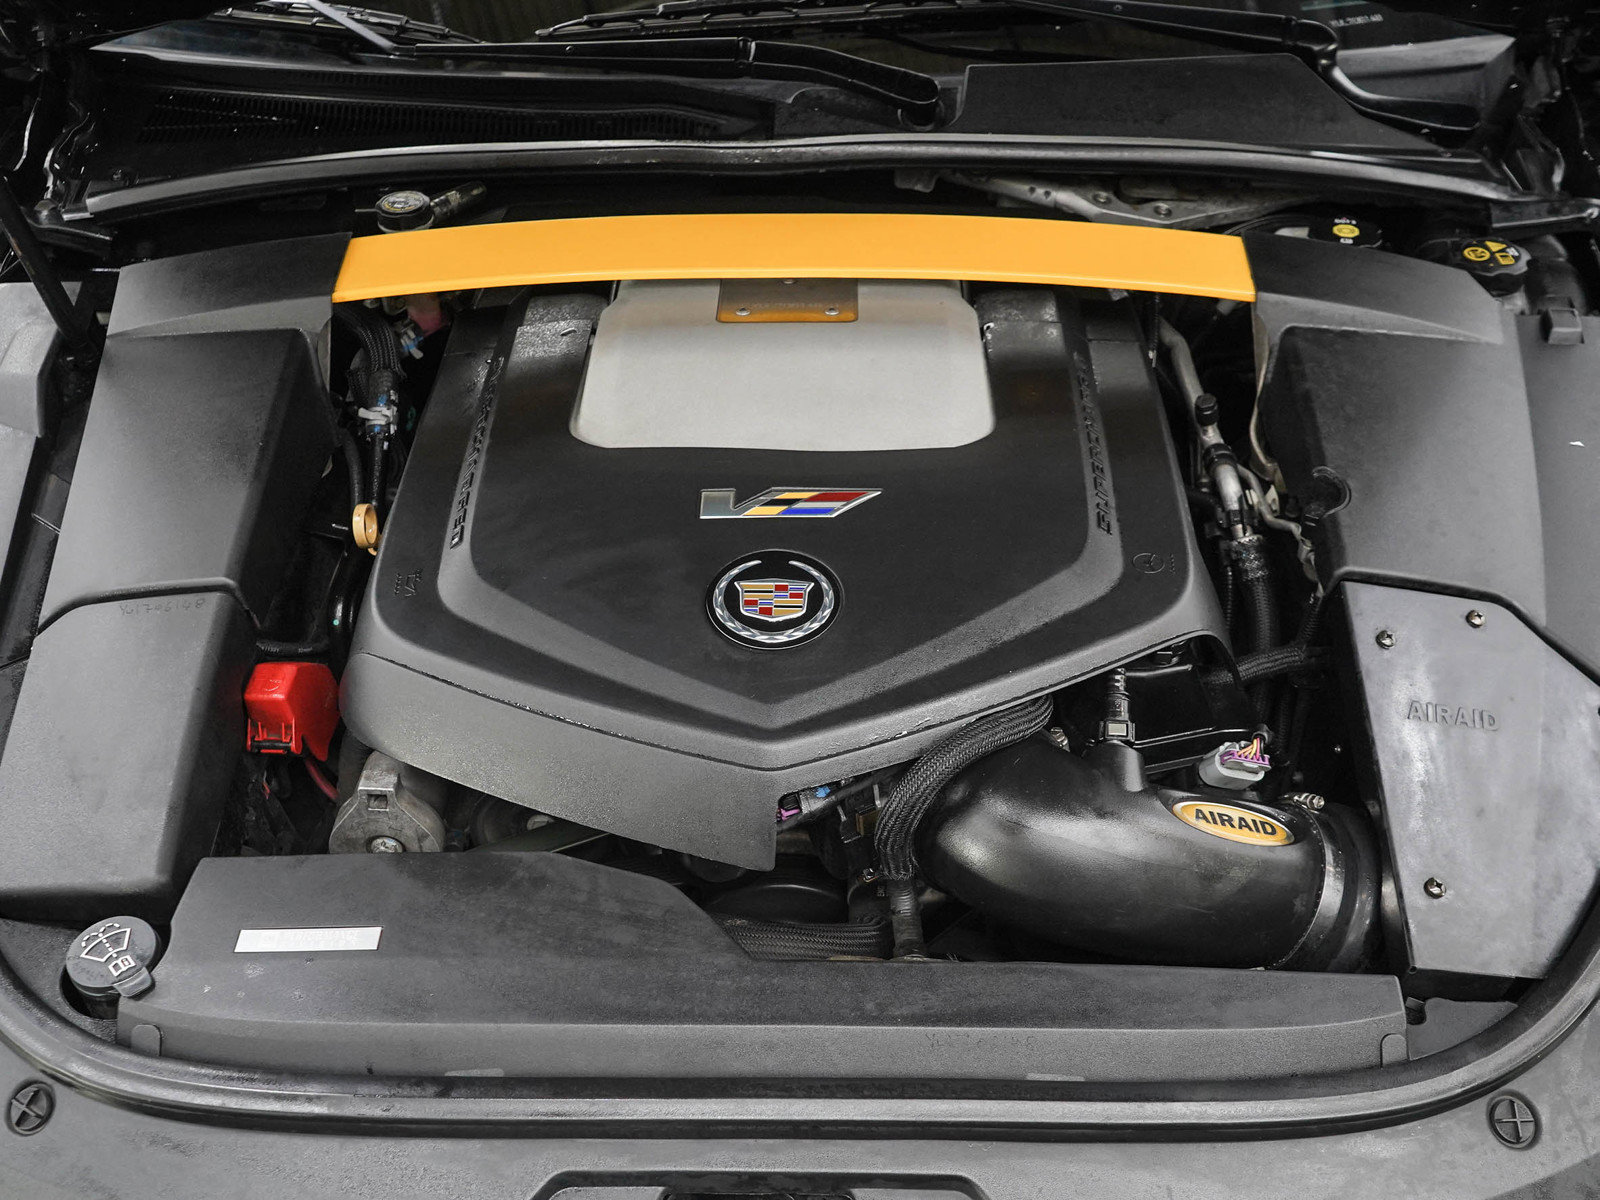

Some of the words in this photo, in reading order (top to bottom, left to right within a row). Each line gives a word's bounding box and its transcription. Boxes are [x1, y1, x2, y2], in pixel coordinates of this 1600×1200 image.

[1073, 351, 1113, 536] SUPERCHARG
[1407, 699, 1500, 732] AIRAID
[1194, 808, 1277, 836] AIRAID
